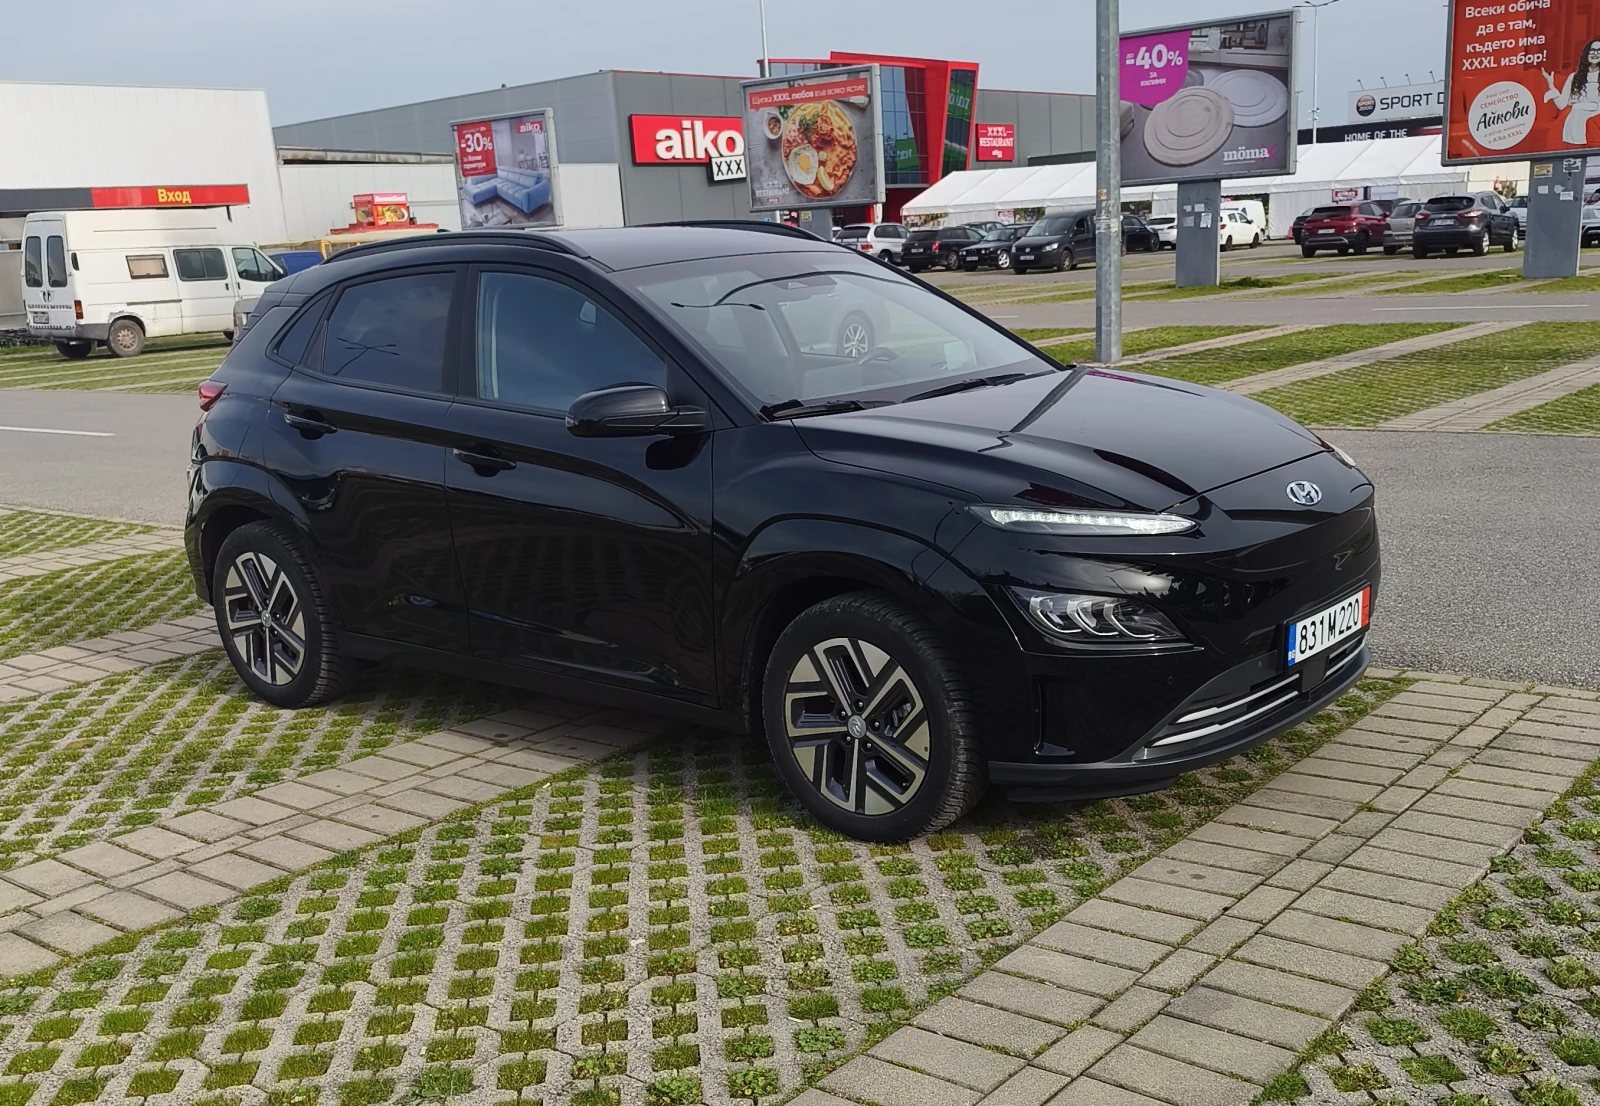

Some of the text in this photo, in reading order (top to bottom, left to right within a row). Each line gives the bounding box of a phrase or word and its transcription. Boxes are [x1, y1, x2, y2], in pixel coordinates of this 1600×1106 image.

[1465, 0, 1551, 18] Всеки обича
[1476, 19, 1536, 36] да е там,
[1466, 34, 1545, 53] където има
[1125, 44, 1183, 69] -40%
[1462, 50, 1547, 71] XXXL избор!
[791, 90, 814, 100] любов
[1380, 93, 1433, 111] SPORT
[1480, 93, 1519, 110] СЕМЕЙСТВО
[1476, 100, 1530, 132] Айкови
[520, 122, 540, 133] aiko
[1344, 131, 1371, 142] HOME
[1389, 128, 1408, 138] THE
[460, 133, 493, 153] -30%
[655, 120, 745, 160] aiko
[979, 137, 1014, 147] RESTAURANT
[157, 188, 192, 203] Вход
